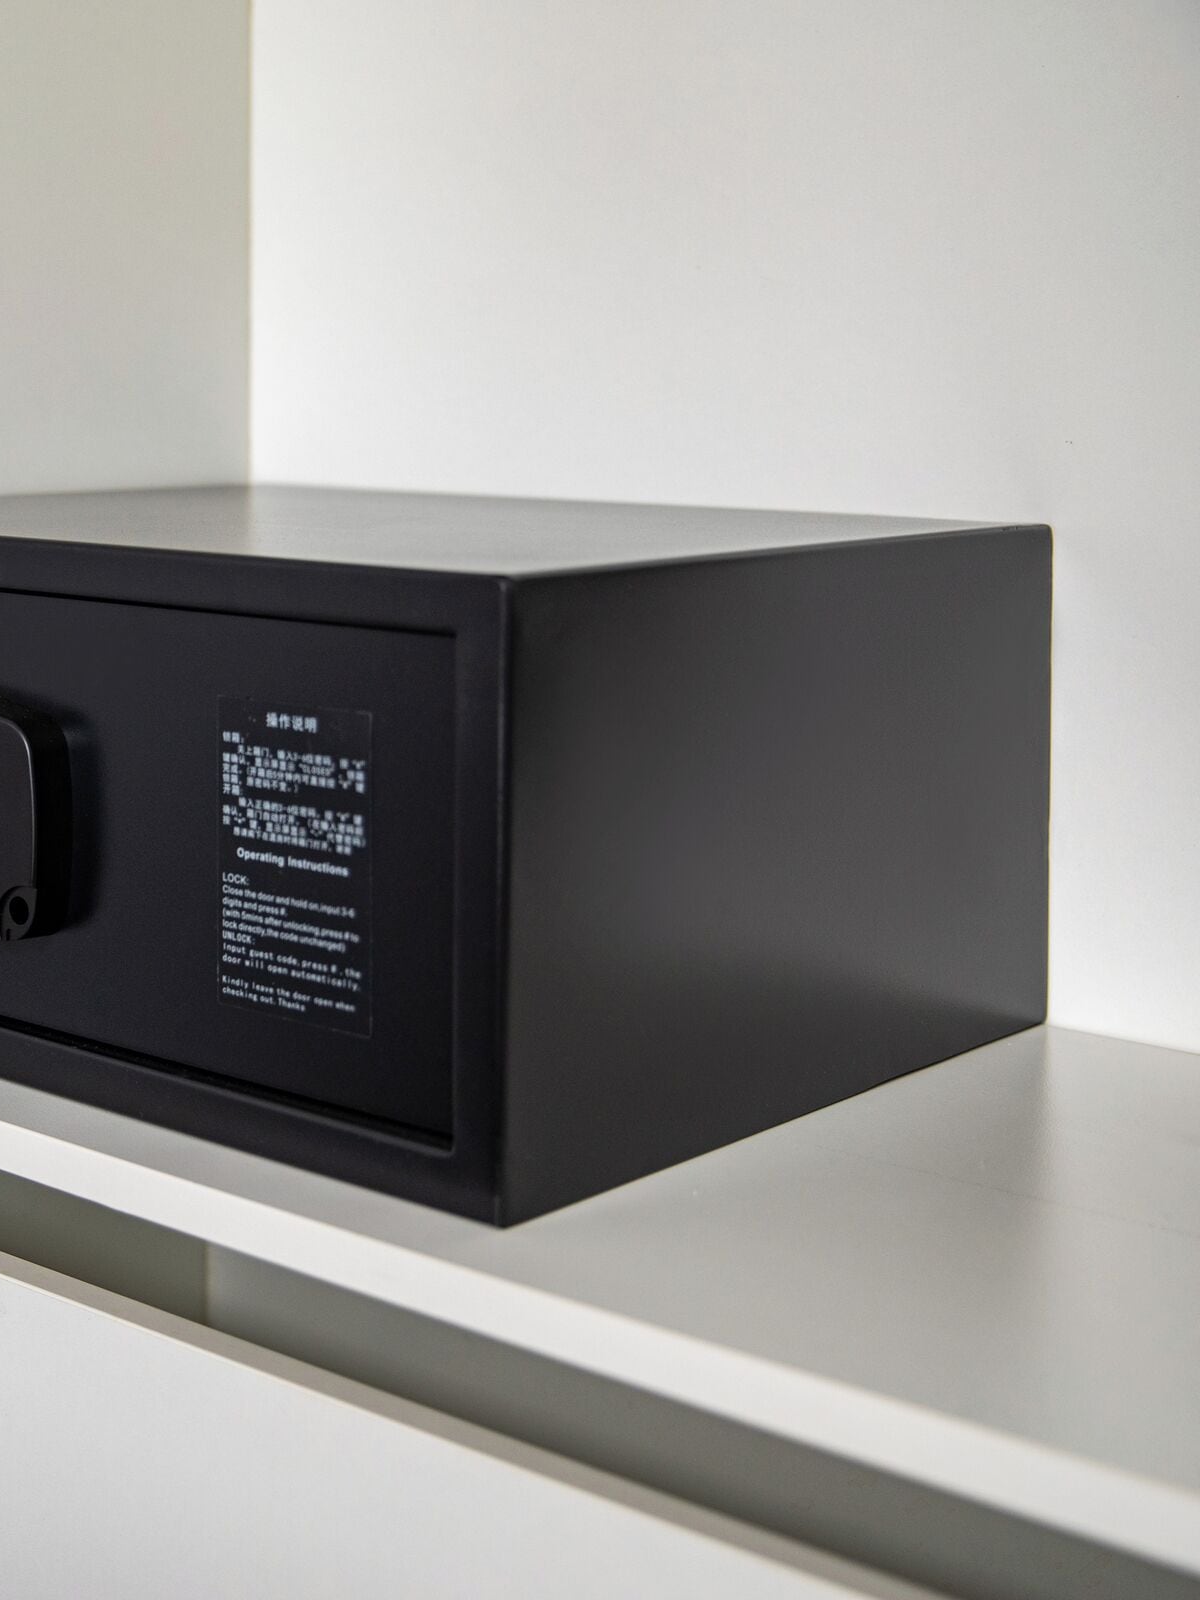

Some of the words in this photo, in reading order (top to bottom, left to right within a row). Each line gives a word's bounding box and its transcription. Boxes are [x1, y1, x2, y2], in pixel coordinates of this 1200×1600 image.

[237, 847, 284, 867] Operating
[288, 855, 349, 877] Instructions
[222, 885, 243, 897] Close
[244, 888, 256, 899] the
[258, 892, 274, 902] door
[276, 896, 290, 906] and
[222, 897, 242, 909] digits
[243, 900, 257, 910] and
[259, 904, 280, 915] press
[222, 919, 238, 930] lock
[222, 953, 241, 964] door
[244, 959, 264, 970] will
[268, 965, 288, 976] open
[222, 975, 248, 989] Kindly
[252, 981, 273, 994] leave
[277, 987, 291, 998] the
[222, 987, 258, 1002] checking
[278, 997, 306, 1011] Thanks
